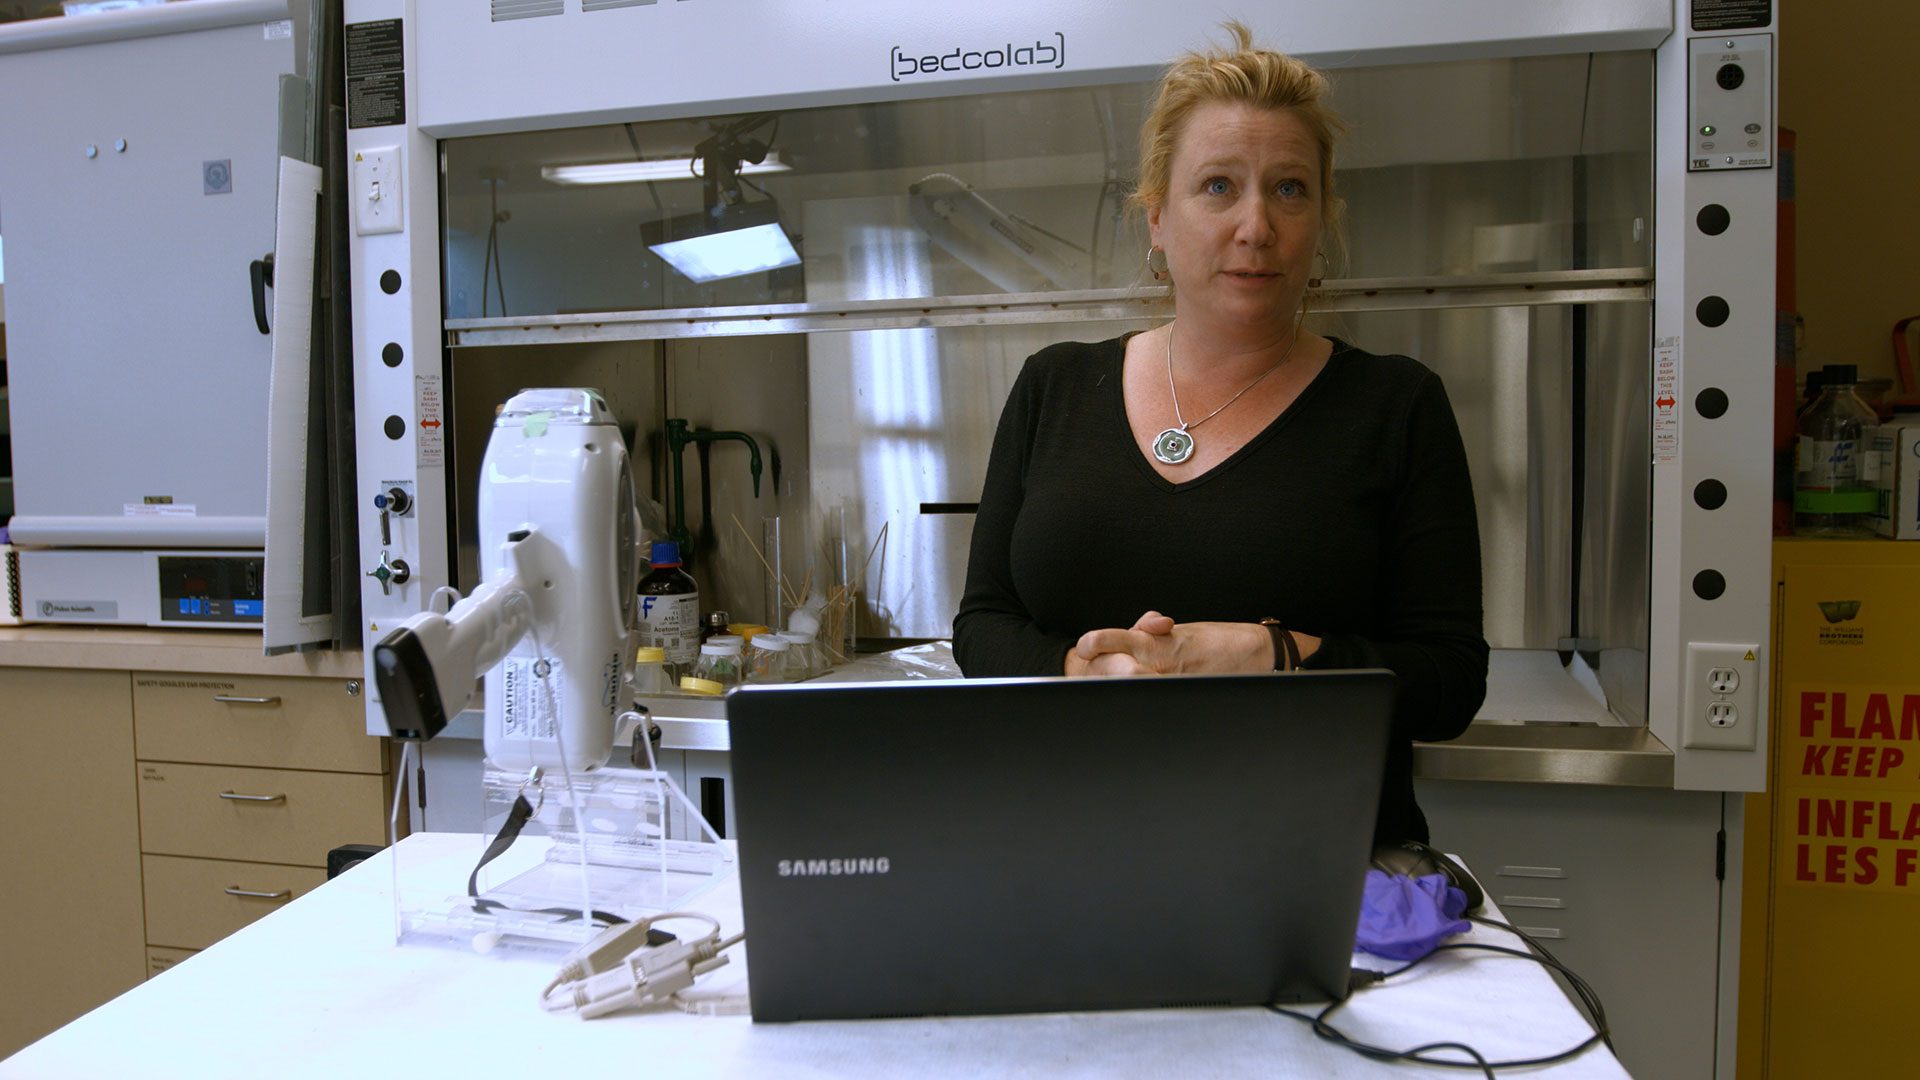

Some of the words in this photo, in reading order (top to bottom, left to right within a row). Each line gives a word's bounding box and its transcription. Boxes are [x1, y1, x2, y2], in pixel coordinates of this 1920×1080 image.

[505, 671, 514, 723] CAUTION
[1802, 745, 1904, 778] KEEP
[778, 857, 890, 876] SAMSUNG
[1796, 844, 1879, 885] LES
